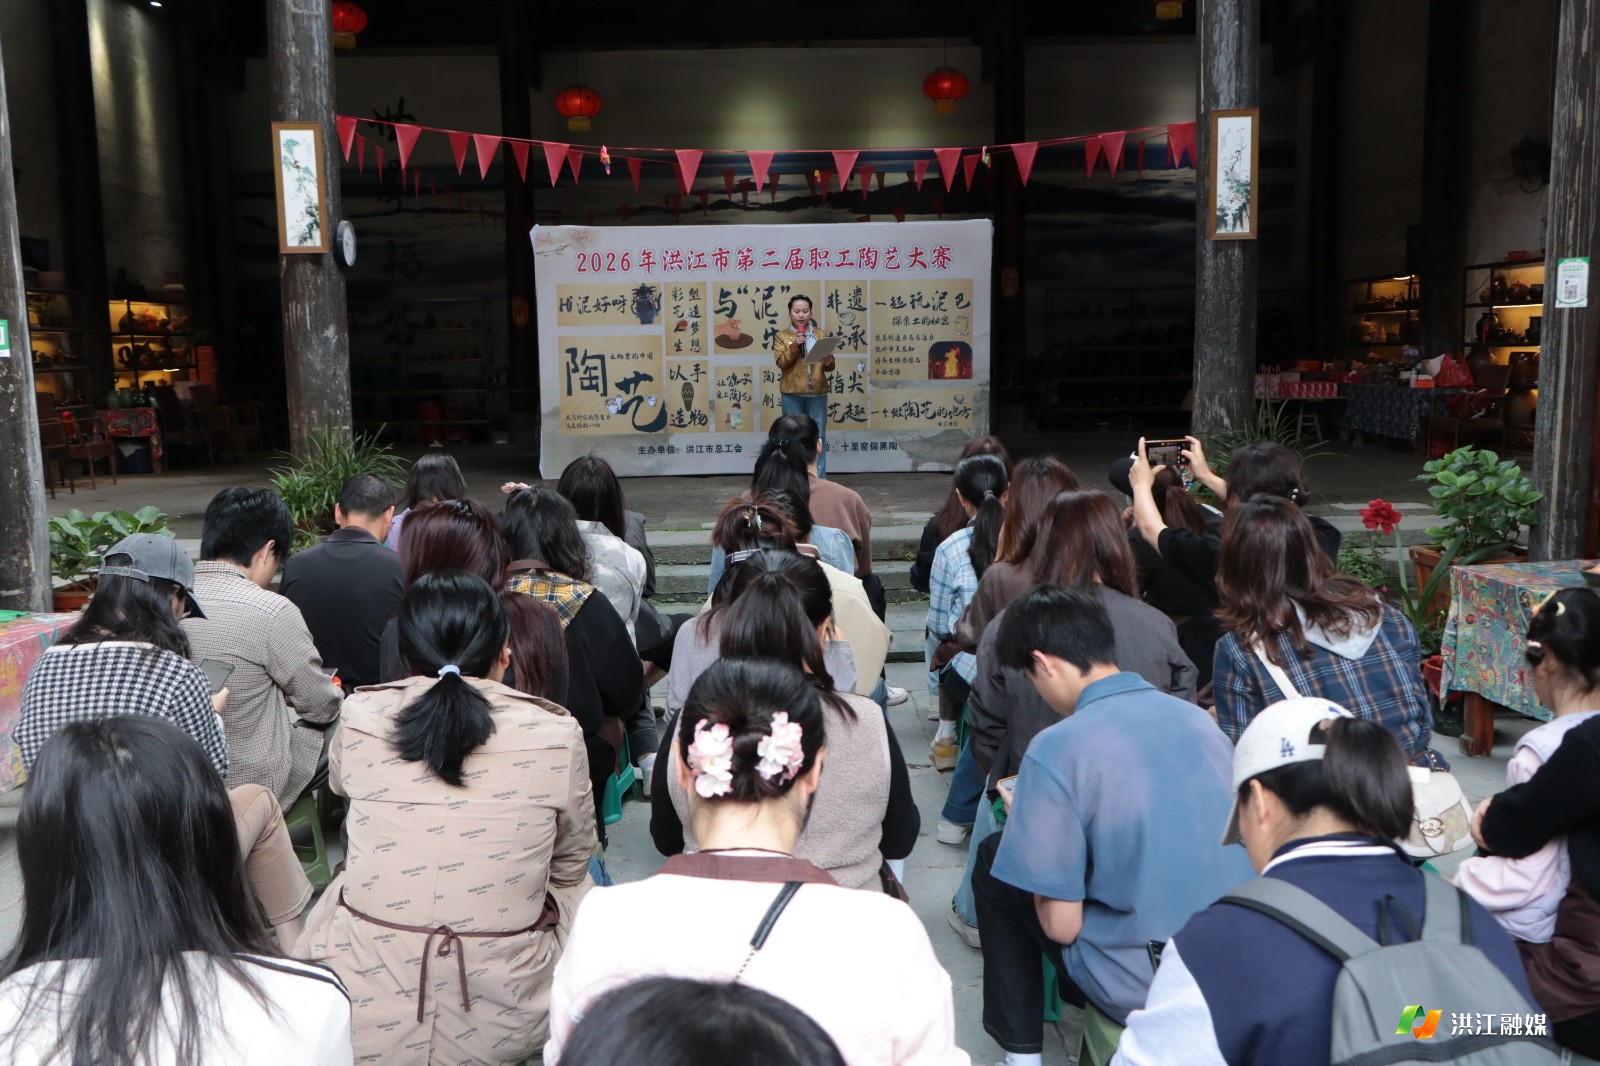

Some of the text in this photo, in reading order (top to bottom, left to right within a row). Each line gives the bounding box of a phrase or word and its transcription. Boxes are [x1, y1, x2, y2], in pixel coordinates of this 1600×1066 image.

[576, 245, 953, 275] 2026年洪江市第二届职工陶艺大赛
[826, 286, 868, 314] 非遗
[874, 289, 971, 313] 一起玩泥巴
[669, 363, 707, 383] 以手
[827, 371, 865, 395] 指尖
[668, 407, 708, 429] 造物
[870, 400, 972, 421] 一个做陶艺的地方
[1280, 737, 1295, 758] LA
[492, 790, 518, 799] RESOURCES
[460, 828, 487, 838] RESOURCES
[401, 865, 428, 876] RESOURCES
[467, 882, 495, 894] RESOURCES
[386, 899, 411, 909] RESOURCES
[449, 916, 475, 927] RESOURCES
[376, 1020, 402, 1030] RESOURCES
